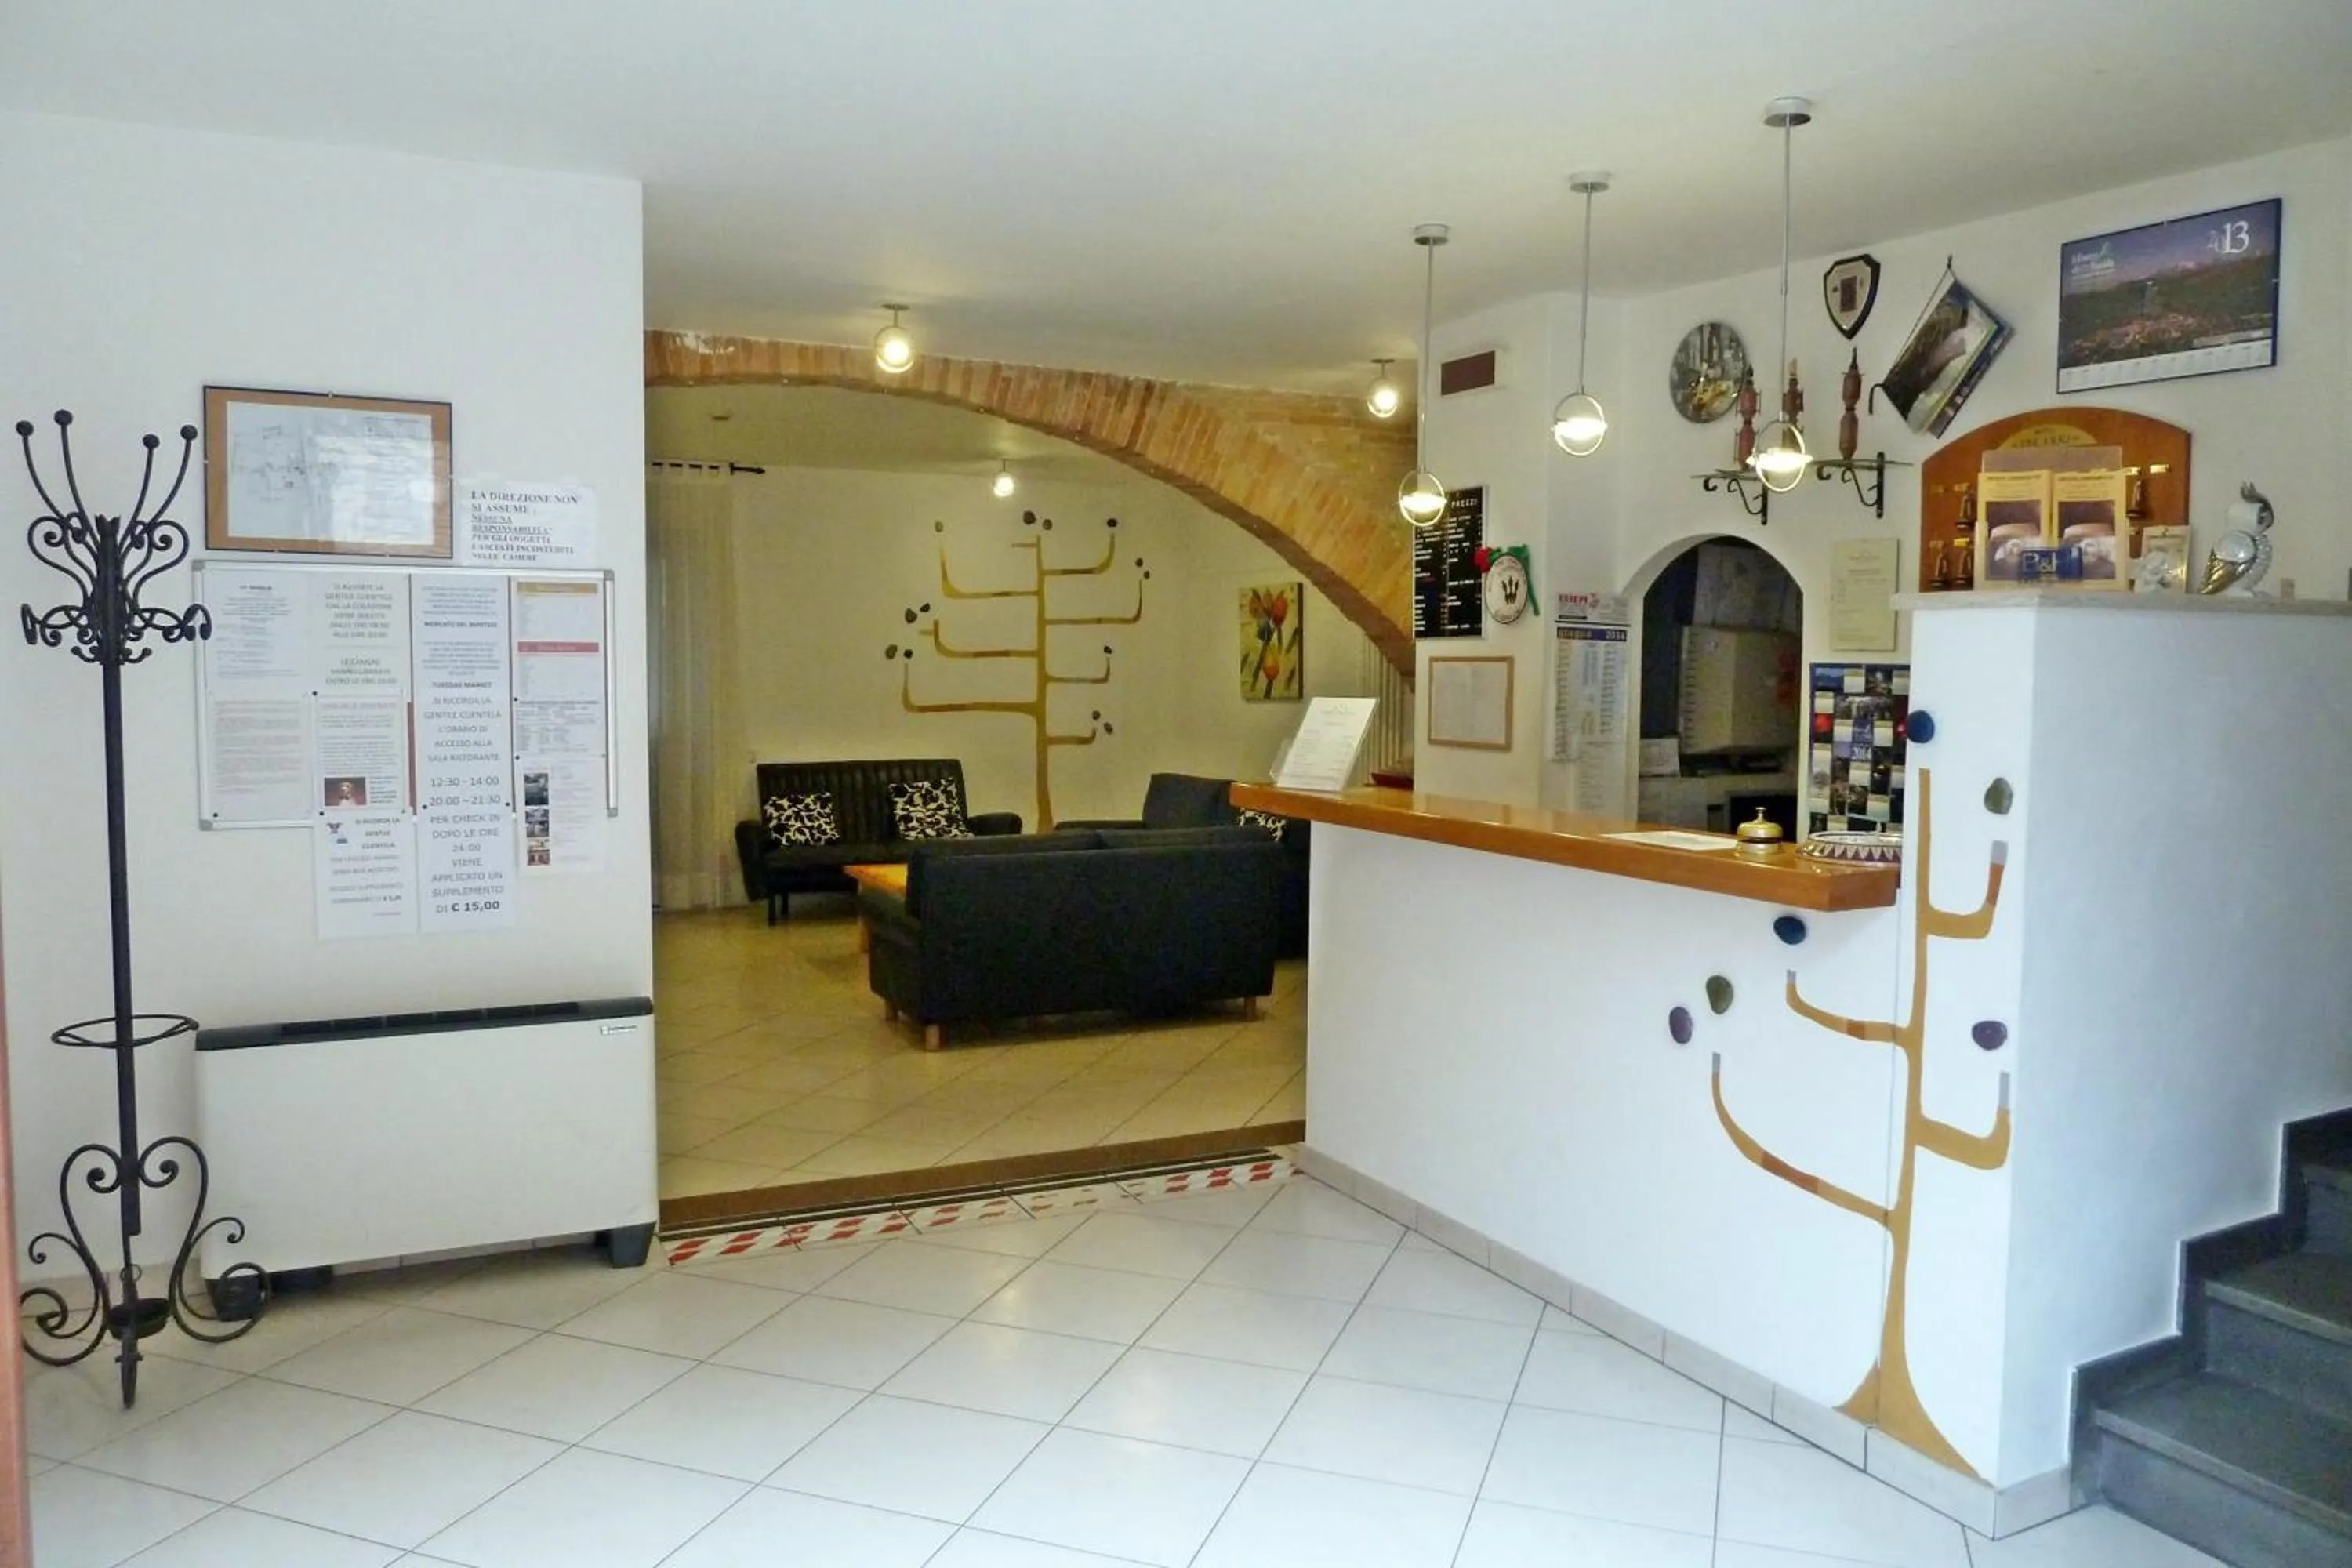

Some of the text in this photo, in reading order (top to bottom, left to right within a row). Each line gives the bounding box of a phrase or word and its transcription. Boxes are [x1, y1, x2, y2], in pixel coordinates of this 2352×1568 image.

[470, 490, 578, 503] LA DIREZIONE NON
[486, 504, 528, 514] ASSUME
[430, 815, 448, 824] PER
[452, 814, 485, 824] CHECK
[432, 829, 461, 839] DOPO
[452, 858, 483, 867] VIENE
[431, 871, 486, 883] APPLICATO
[431, 884, 504, 898] SUPPLEMENTO
[436, 900, 500, 913] DI € 15,00
